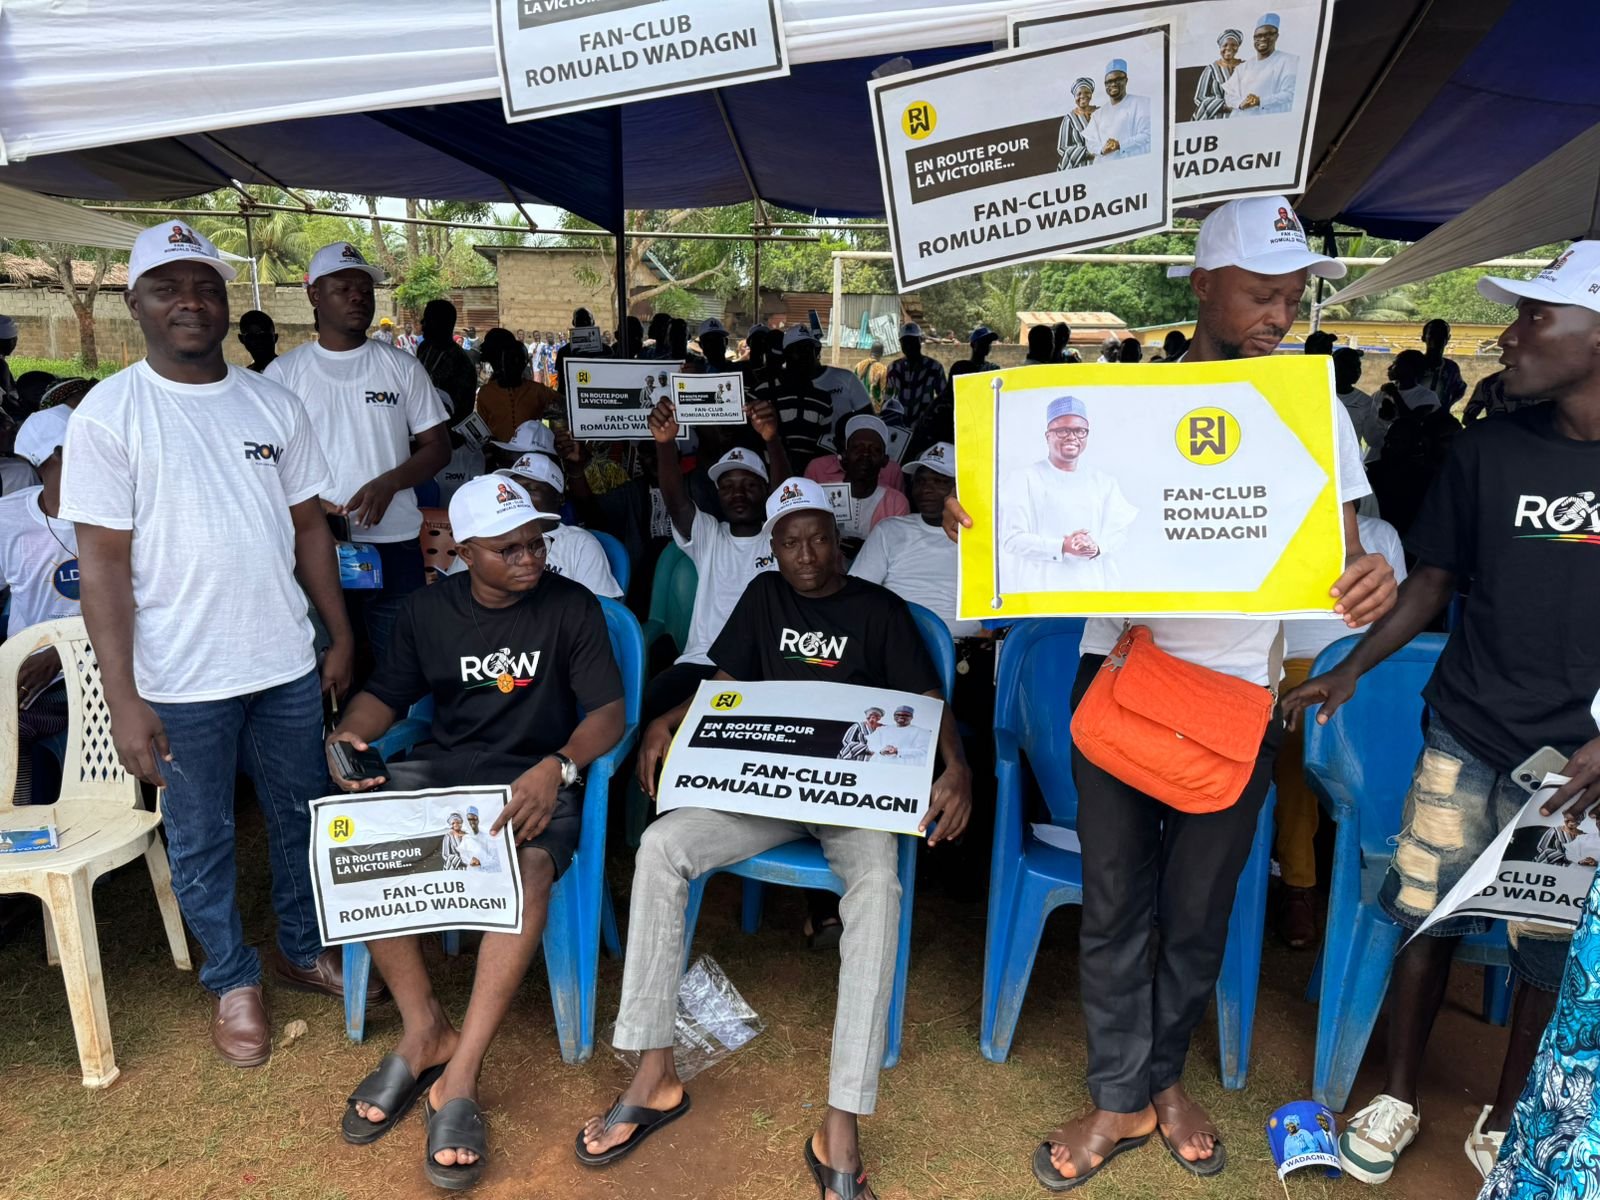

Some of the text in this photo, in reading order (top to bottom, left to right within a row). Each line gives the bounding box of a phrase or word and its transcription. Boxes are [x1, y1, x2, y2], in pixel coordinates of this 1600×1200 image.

[524, 3, 543, 15] LA
[579, 14, 692, 52] FAN-CLUB
[525, 27, 758, 88] ROMUALD WADAGNI
[914, 137, 1030, 174] EN ROUTE POUR
[1174, 135, 1219, 157] LUB
[916, 158, 1015, 189] LA VICTOIRE...
[972, 183, 1088, 221] FAN-CLUB
[917, 192, 1149, 259] ROMUALD WADAGNI
[364, 391, 400, 405] ROW
[580, 423, 630, 432] ROMUALD
[243, 441, 284, 465] ROW
[1163, 485, 1267, 502] FAN-CLUB
[1163, 505, 1268, 521] ROMUALD
[1514, 494, 1600, 533] RO
[1164, 525, 1267, 541] WADAGNI
[699, 730, 797, 744] LA VICTOIRE...
[703, 722, 815, 735] EN ROUTE POUR
[740, 762, 858, 787] FAN-CLUB
[674, 774, 919, 814] ROMUALD WADAGNI
[335, 847, 422, 866] EN ROUTE POUR
[336, 860, 412, 875] LA VICTOIRE...
[1498, 870, 1557, 888] CLUB
[382, 881, 466, 901] FAN-CLUB
[1502, 886, 1586, 909] WADAG
[339, 896, 507, 924] ROMUALD WADAGNI
